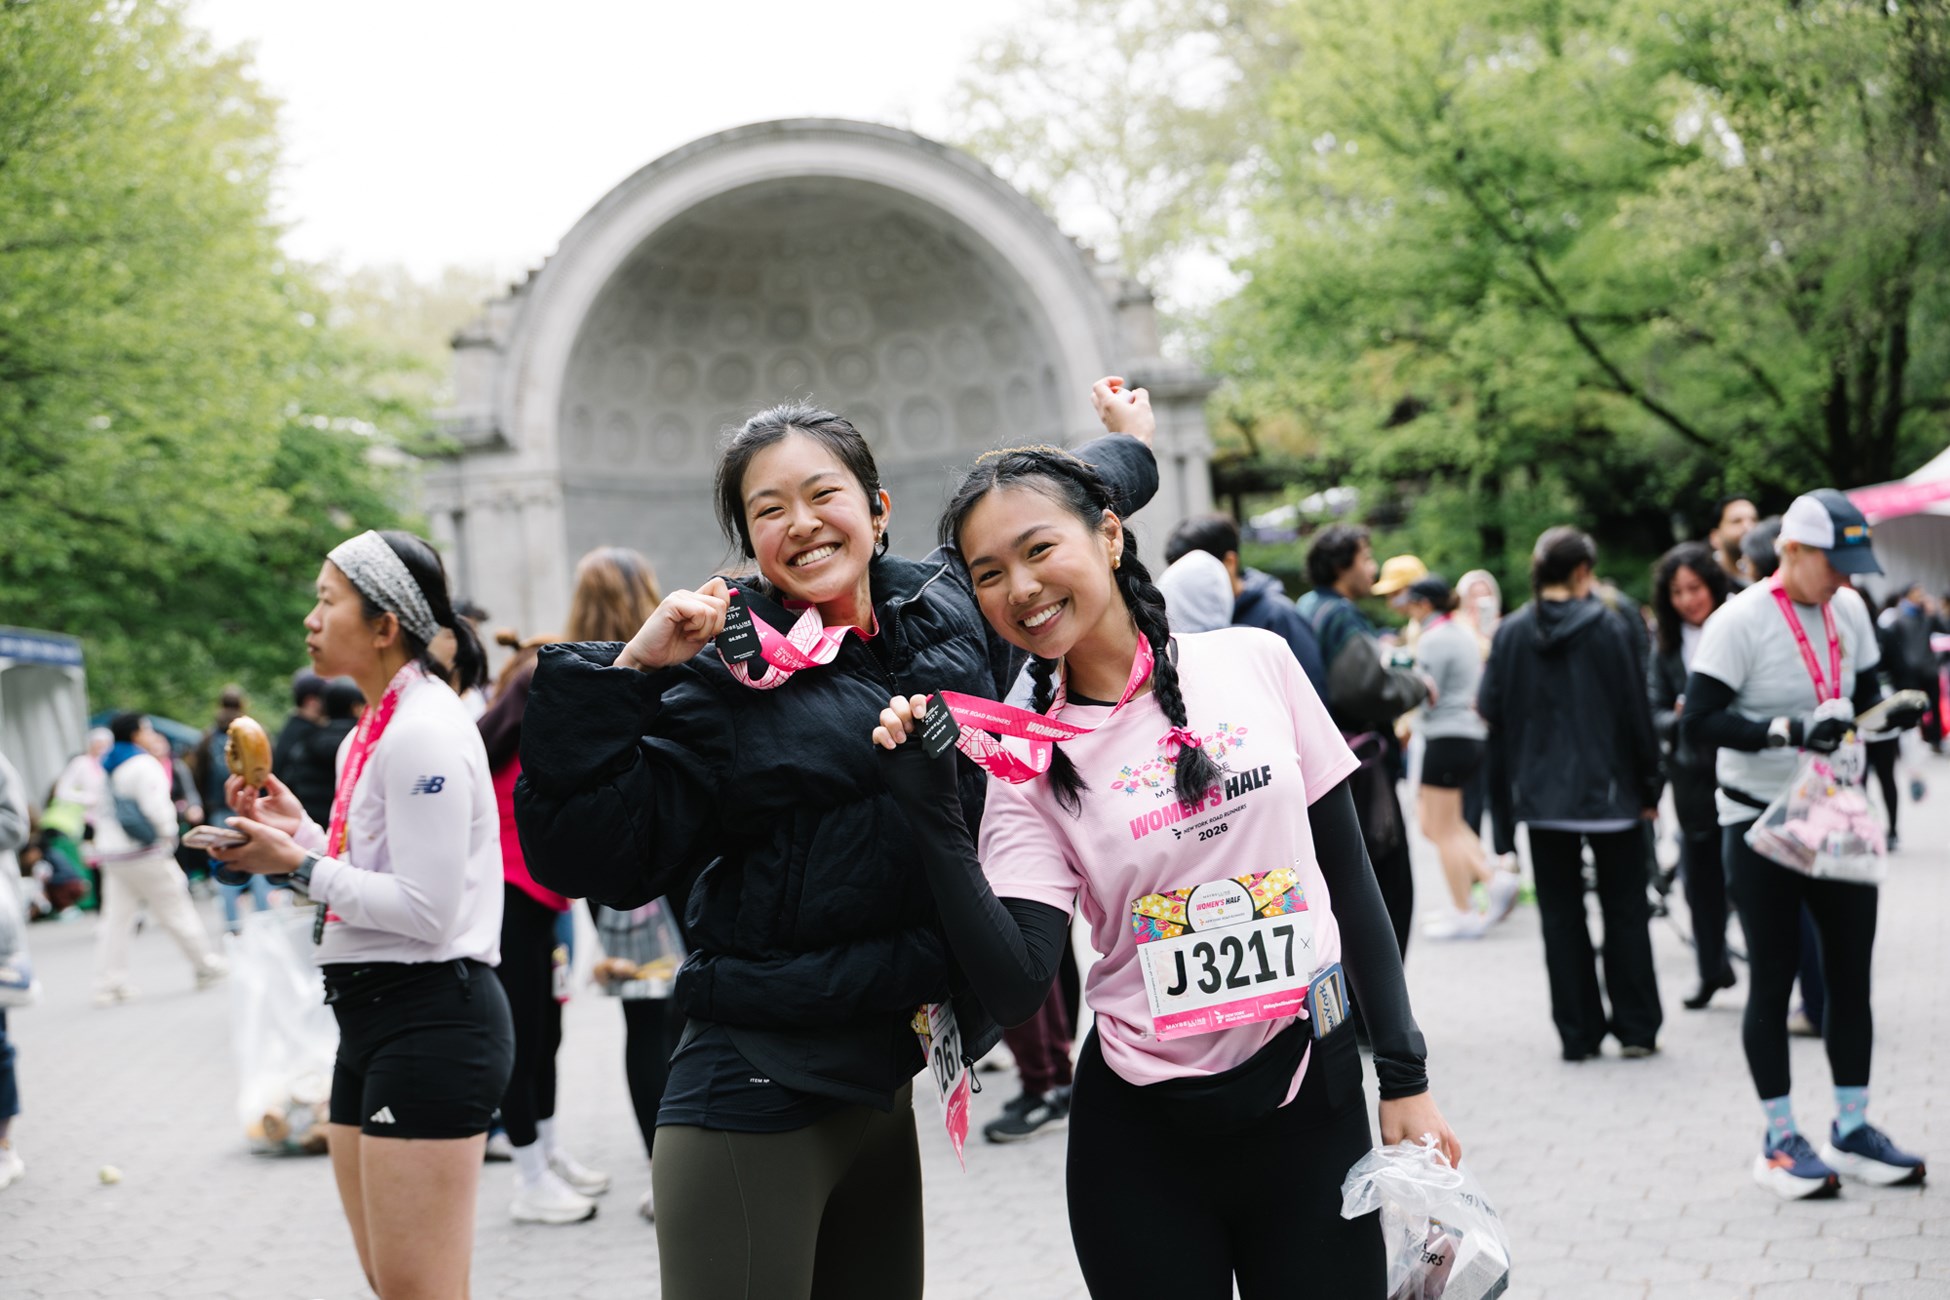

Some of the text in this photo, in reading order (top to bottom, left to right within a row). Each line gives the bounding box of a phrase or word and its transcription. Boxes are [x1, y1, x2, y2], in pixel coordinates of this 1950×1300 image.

[953, 707, 1012, 725] YORK ROAD RUNNERS
[1025, 721, 1074, 739] WOMEN'S
[1224, 765, 1272, 801] HALF
[1183, 803, 1247, 834] NEW YORK ROAD RUNNERS
[1198, 823, 1229, 842] 2026
[1196, 896, 1241, 911] WOMEN'S HALF
[1167, 924, 1295, 996] J3217
